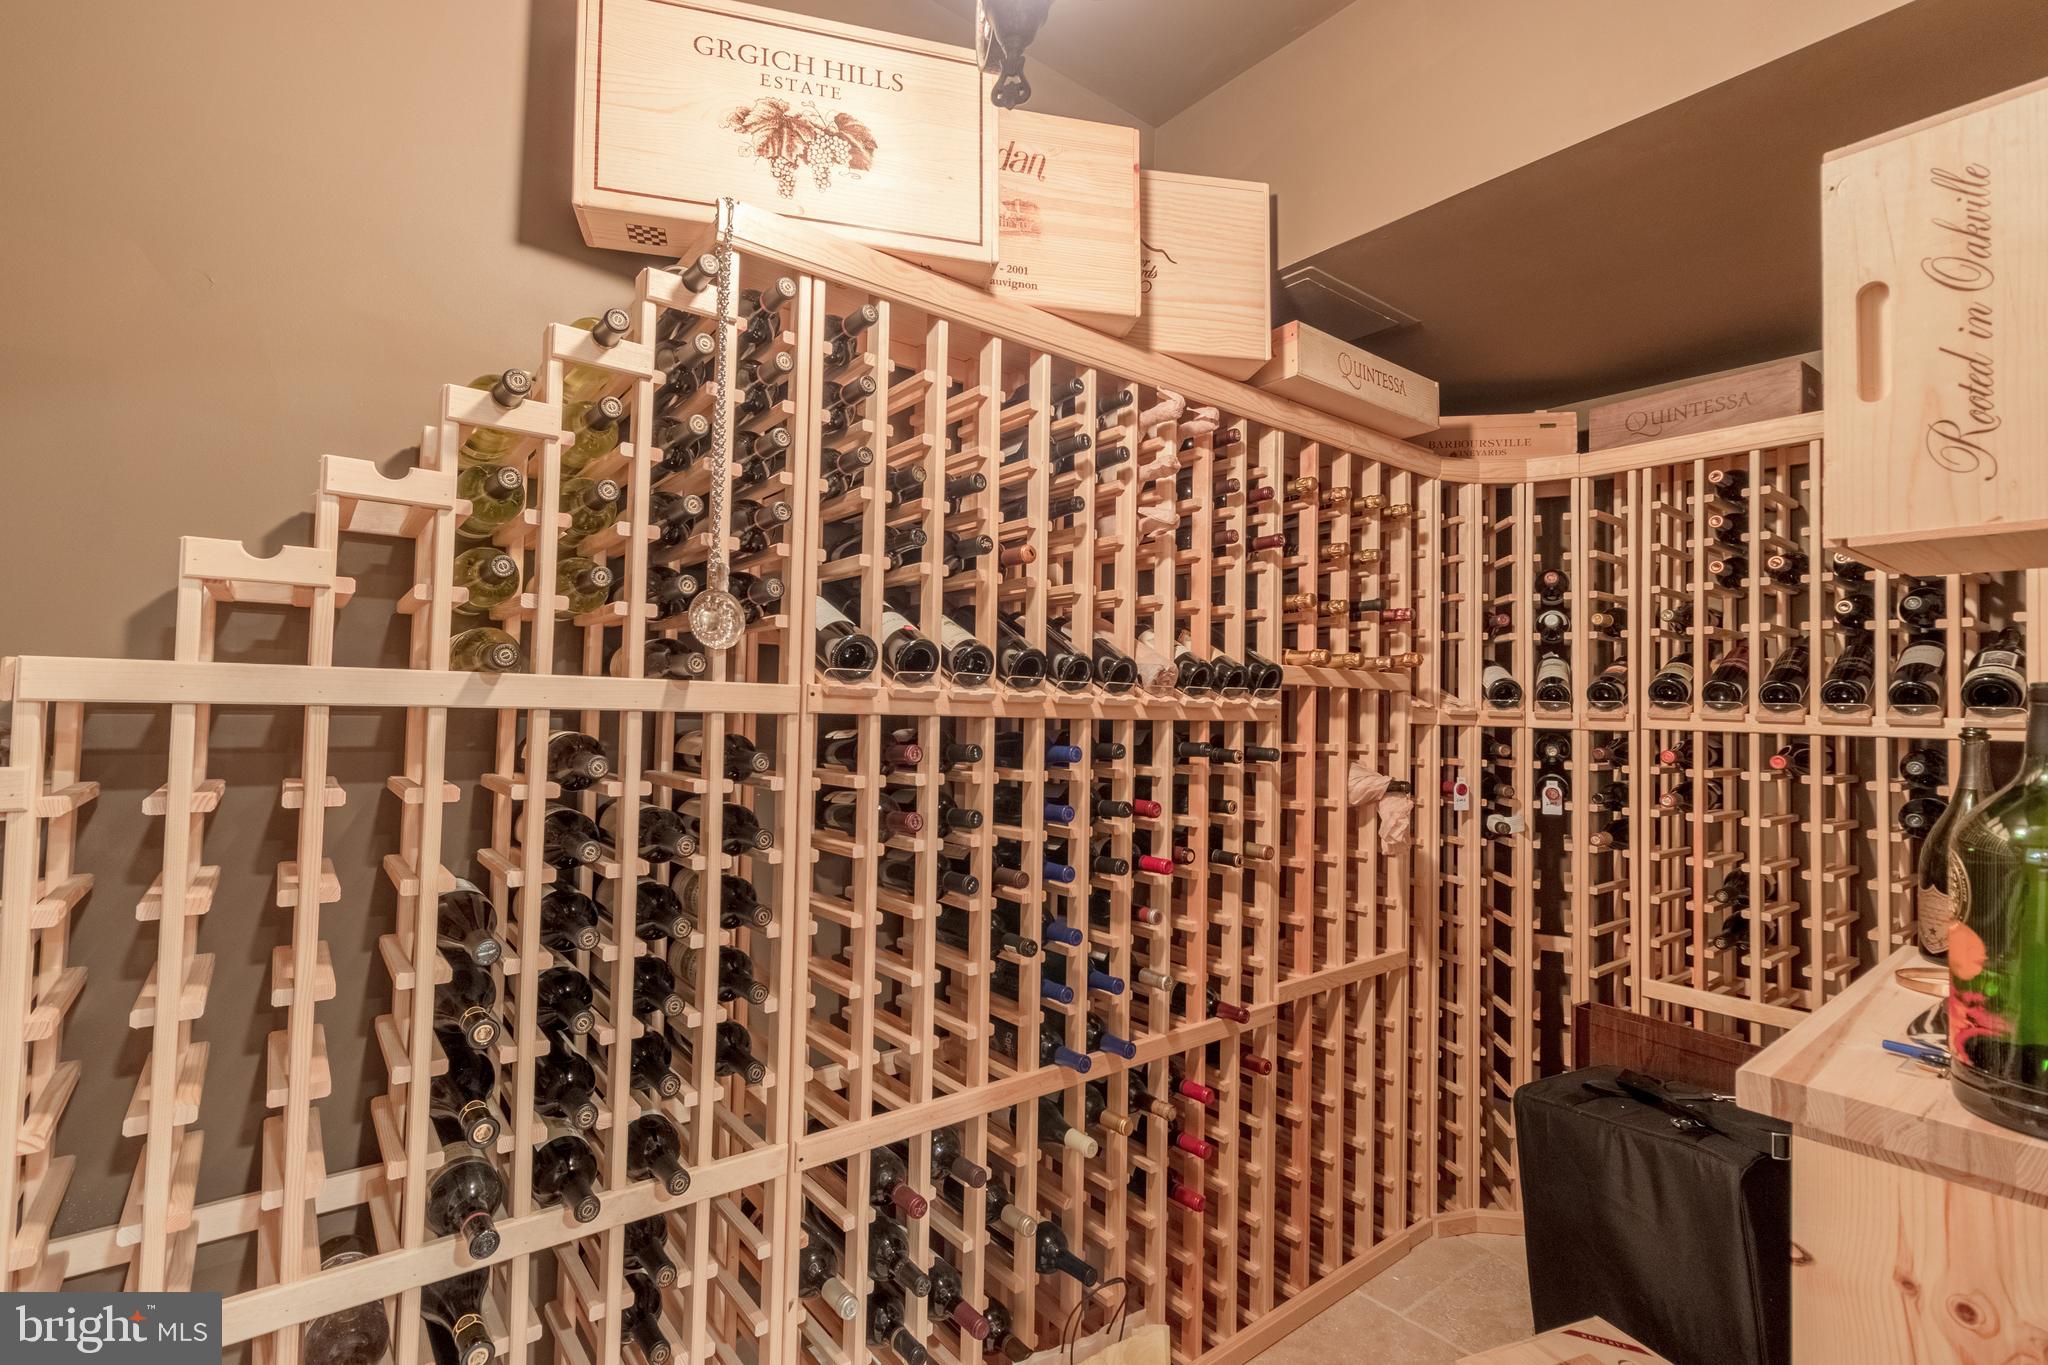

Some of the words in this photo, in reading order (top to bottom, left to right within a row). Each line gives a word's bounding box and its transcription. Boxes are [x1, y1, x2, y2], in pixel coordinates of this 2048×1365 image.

[693, 35, 815, 76] GRGICH
[823, 59, 905, 93] HILLS
[760, 73, 842, 101] ESTATE
[1920, 162, 1995, 292] Oakville
[1006, 264, 1028, 275] 2001
[1958, 301, 1994, 340] in
[1337, 352, 1407, 397] QUINTESSA
[1624, 391, 1752, 437] QUINTESSA
[1926, 346, 2002, 482] Rooted
[1428, 438, 1532, 449] BARBOURSVILLE
